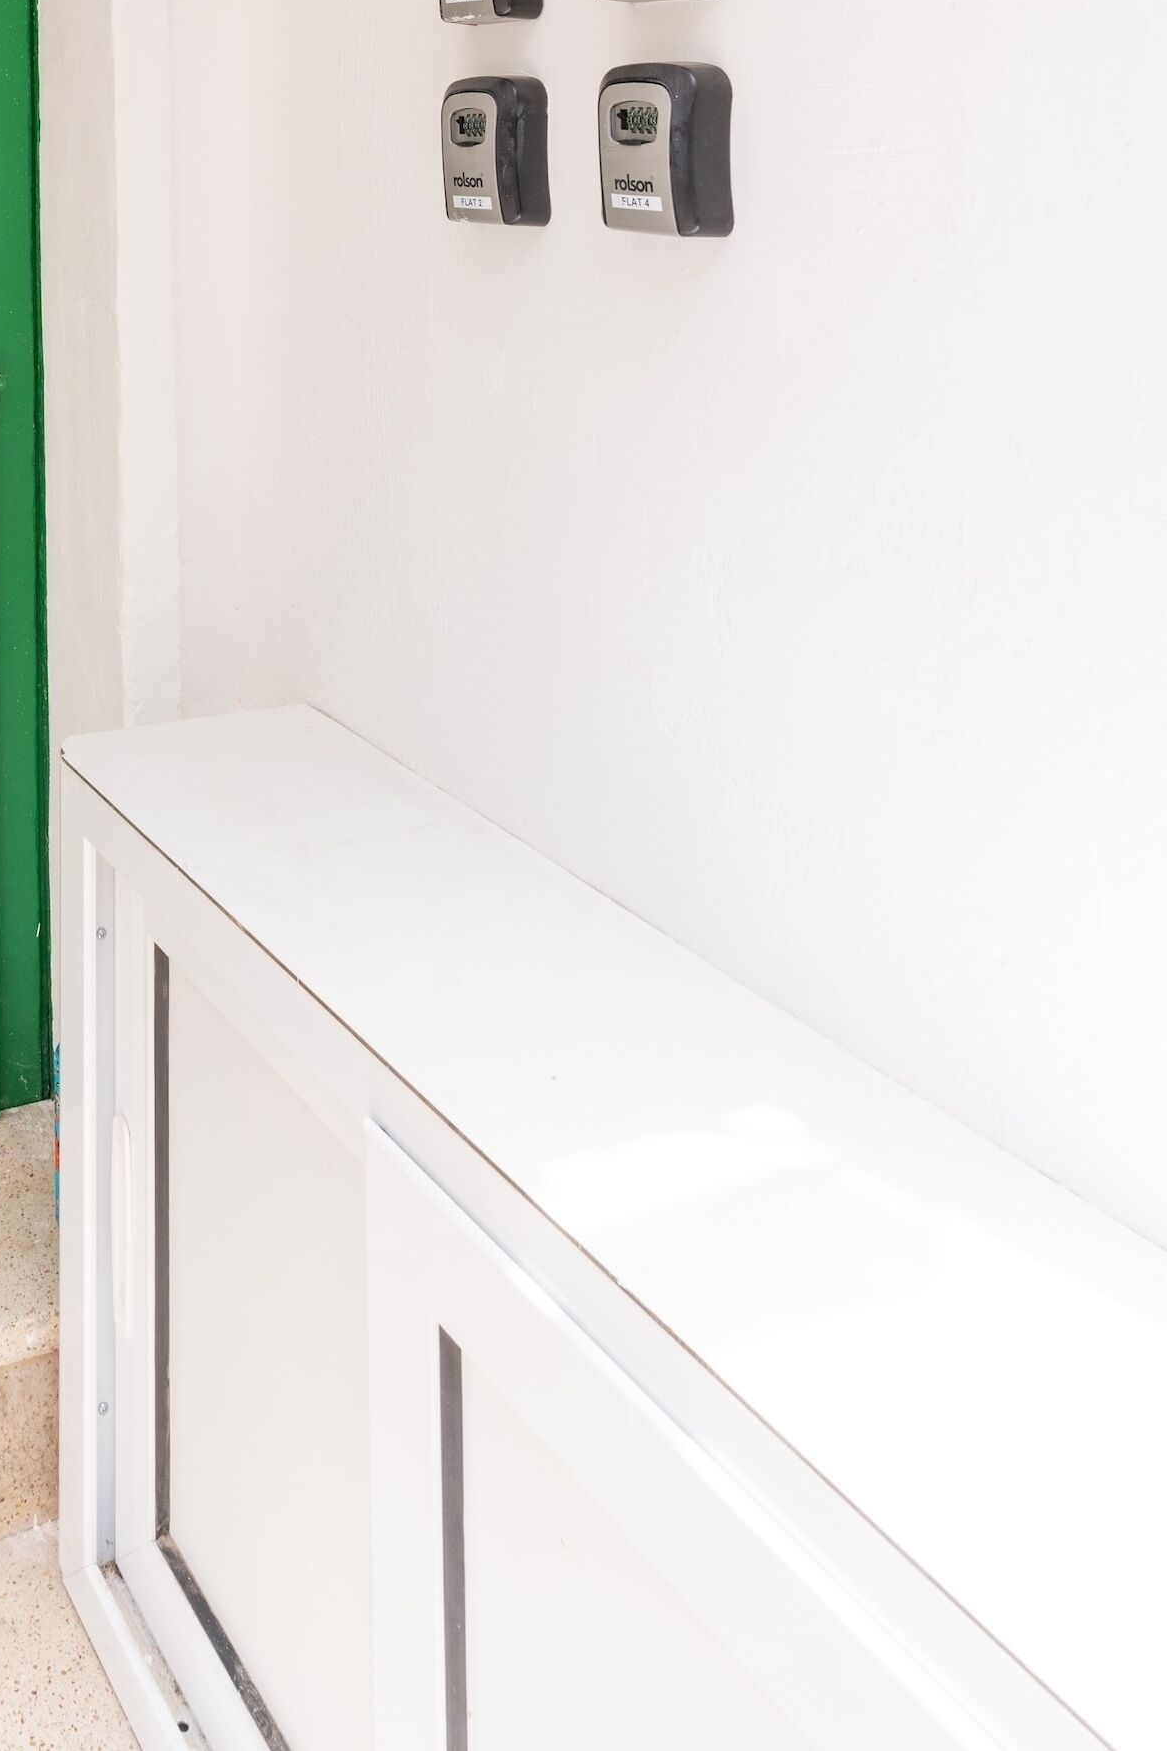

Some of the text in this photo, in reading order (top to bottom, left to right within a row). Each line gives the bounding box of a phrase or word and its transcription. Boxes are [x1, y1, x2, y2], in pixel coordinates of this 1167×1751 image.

[453, 172, 483, 188] rolson
[614, 173, 654, 193] rolson
[460, 198, 483, 207] FLAT 2
[621, 196, 650, 207] FLAT 4
